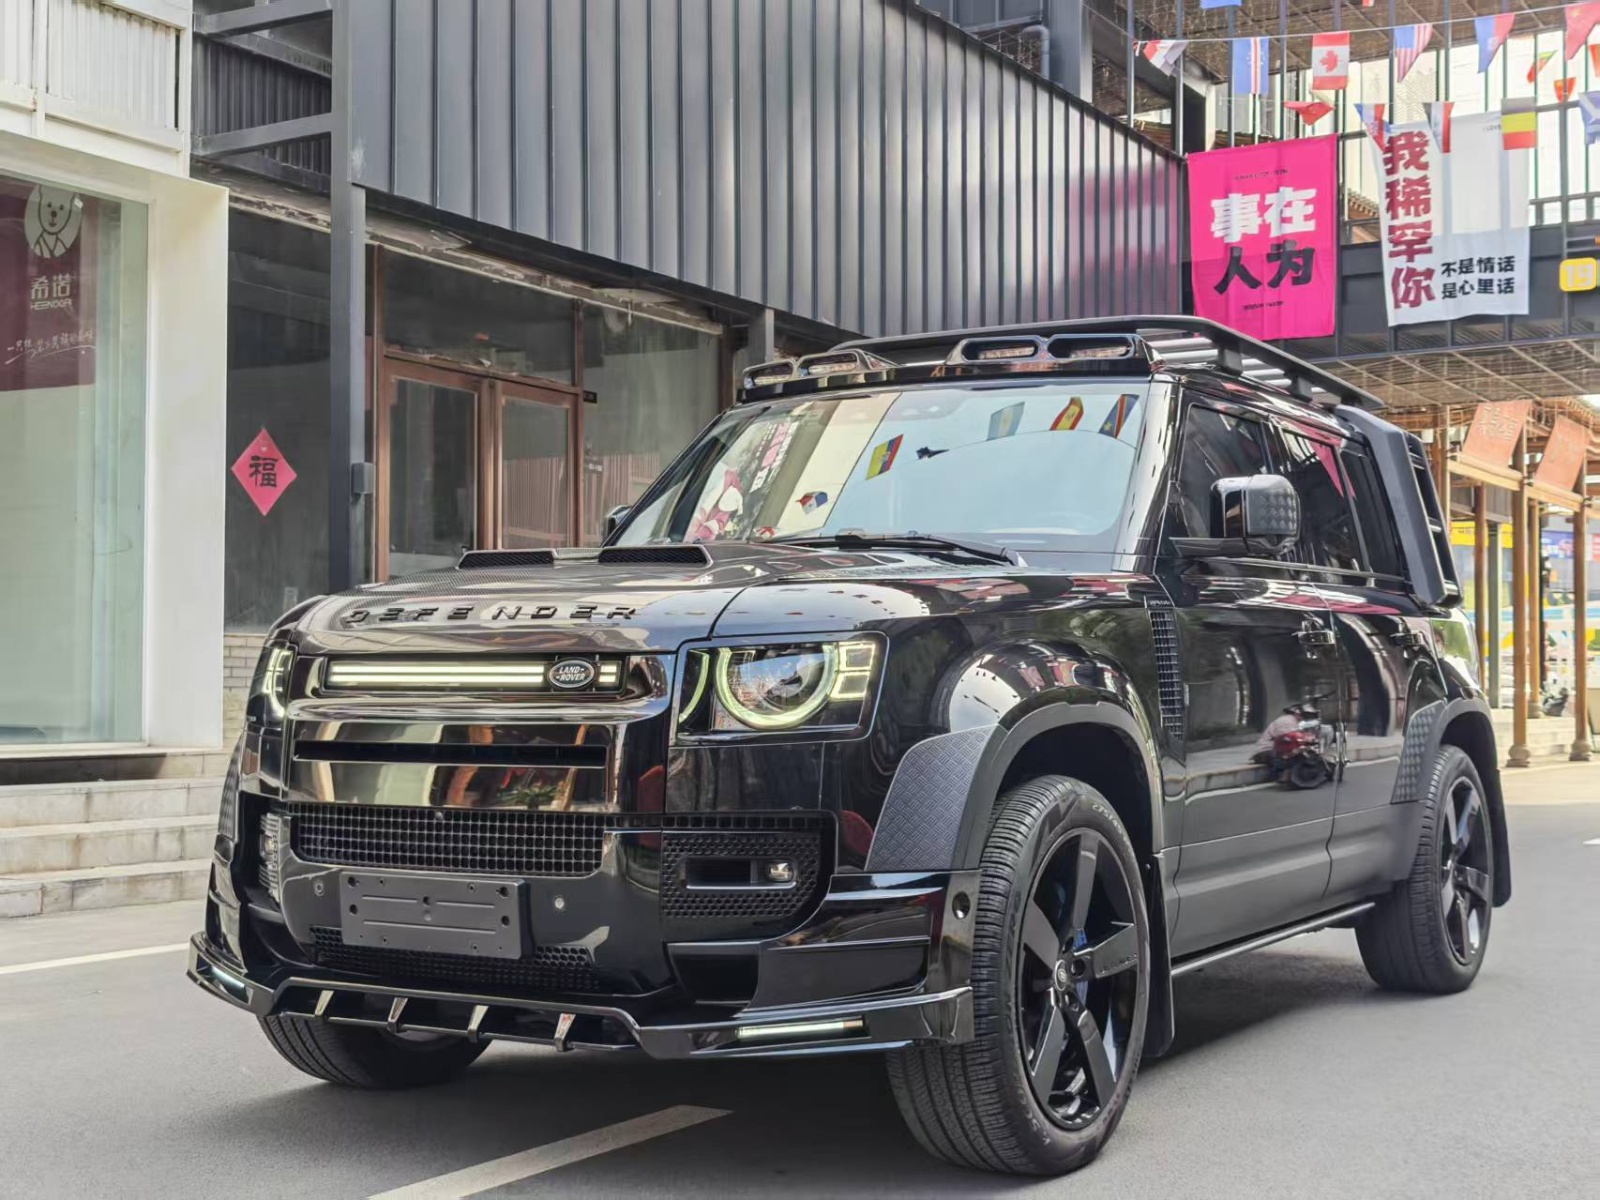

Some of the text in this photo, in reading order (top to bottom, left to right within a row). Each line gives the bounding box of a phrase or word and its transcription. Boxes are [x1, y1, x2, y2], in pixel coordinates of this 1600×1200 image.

[1210, 186, 1317, 243] 事在
[1383, 131, 1435, 309] 我稀罕你
[1213, 239, 1315, 295] 人为
[1441, 256, 1515, 277] 不是情话
[1565, 264, 1594, 288] 19
[1441, 277, 1515, 300] 是心里话
[248, 455, 278, 488] 福
[345, 605, 637, 624] DEFENDER
